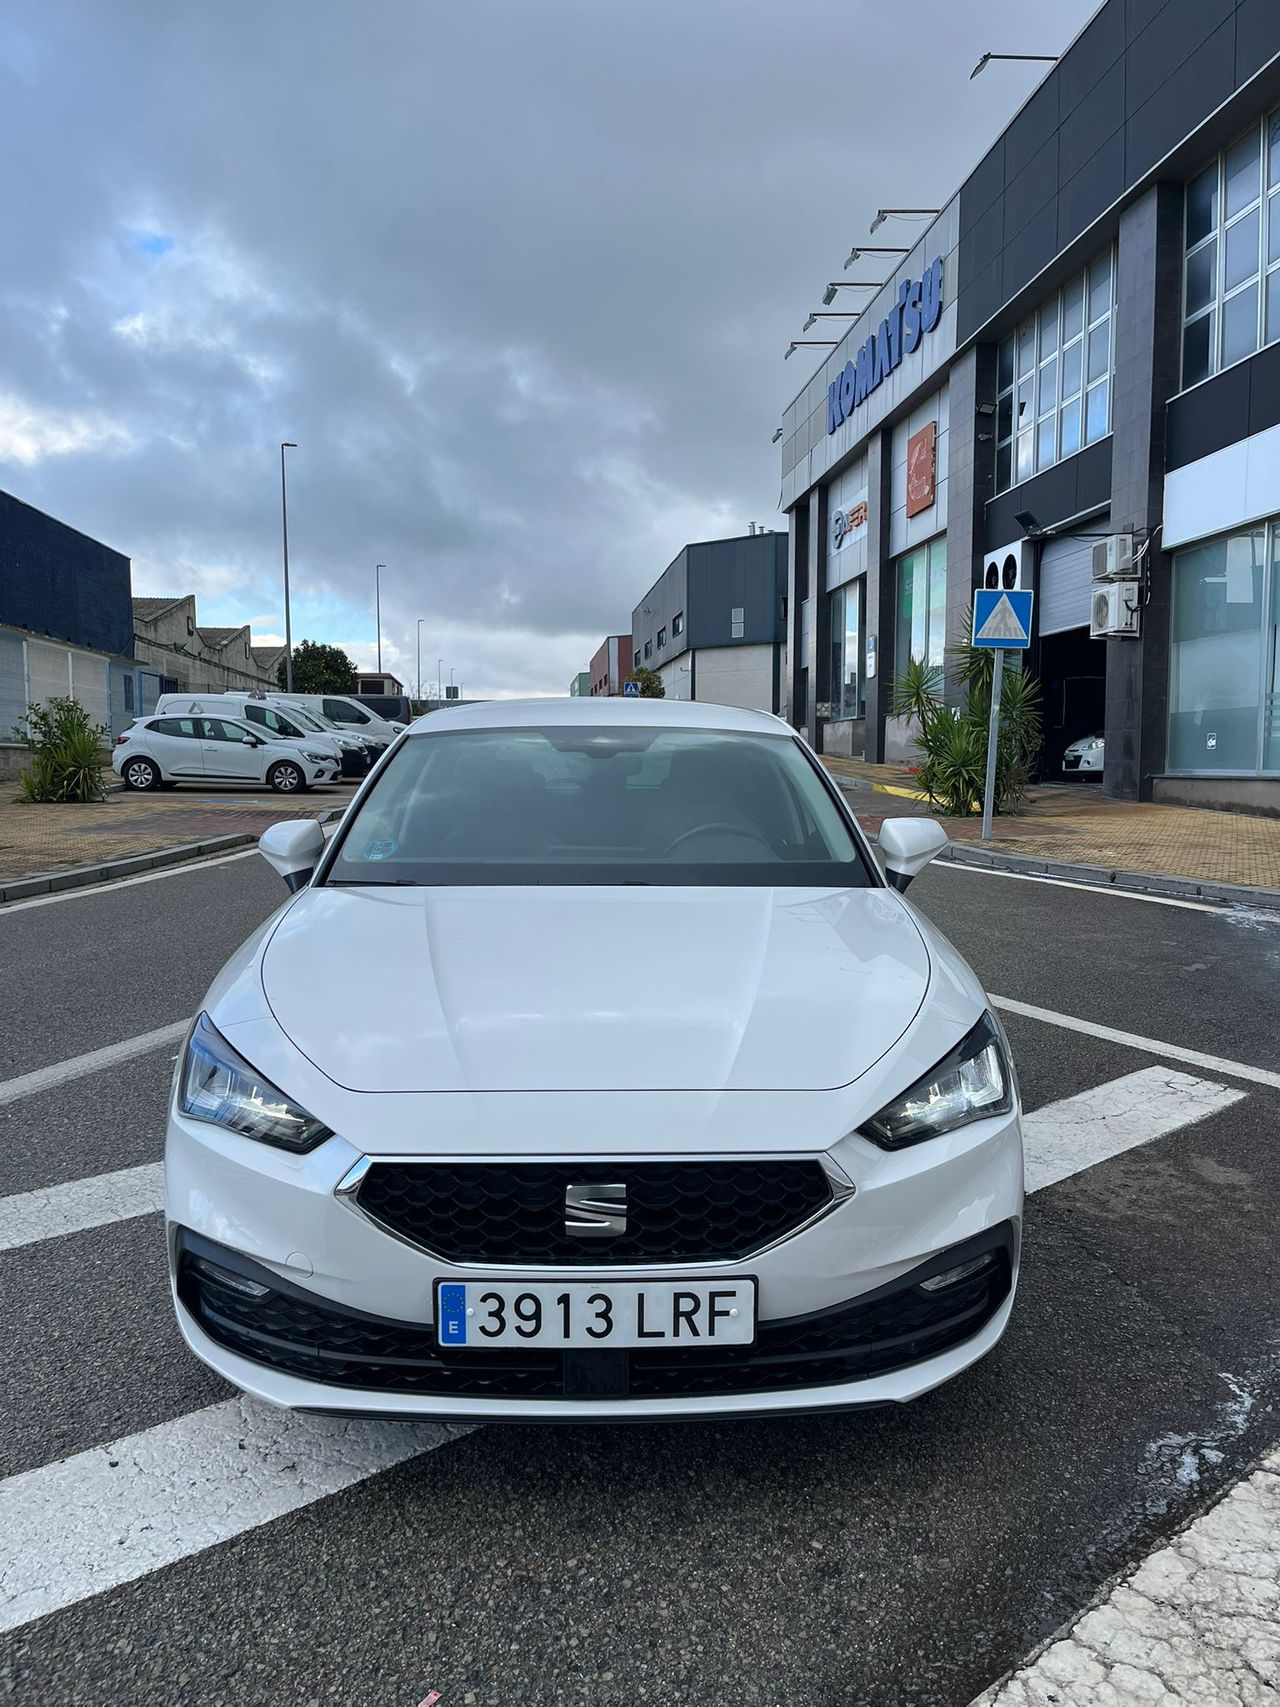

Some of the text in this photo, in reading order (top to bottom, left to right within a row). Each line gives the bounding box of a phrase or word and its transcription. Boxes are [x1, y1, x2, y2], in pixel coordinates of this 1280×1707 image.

[828, 255, 943, 435] KOMATSU
[449, 1321, 459, 1334] E
[478, 1290, 737, 1339] 3913 LRF
